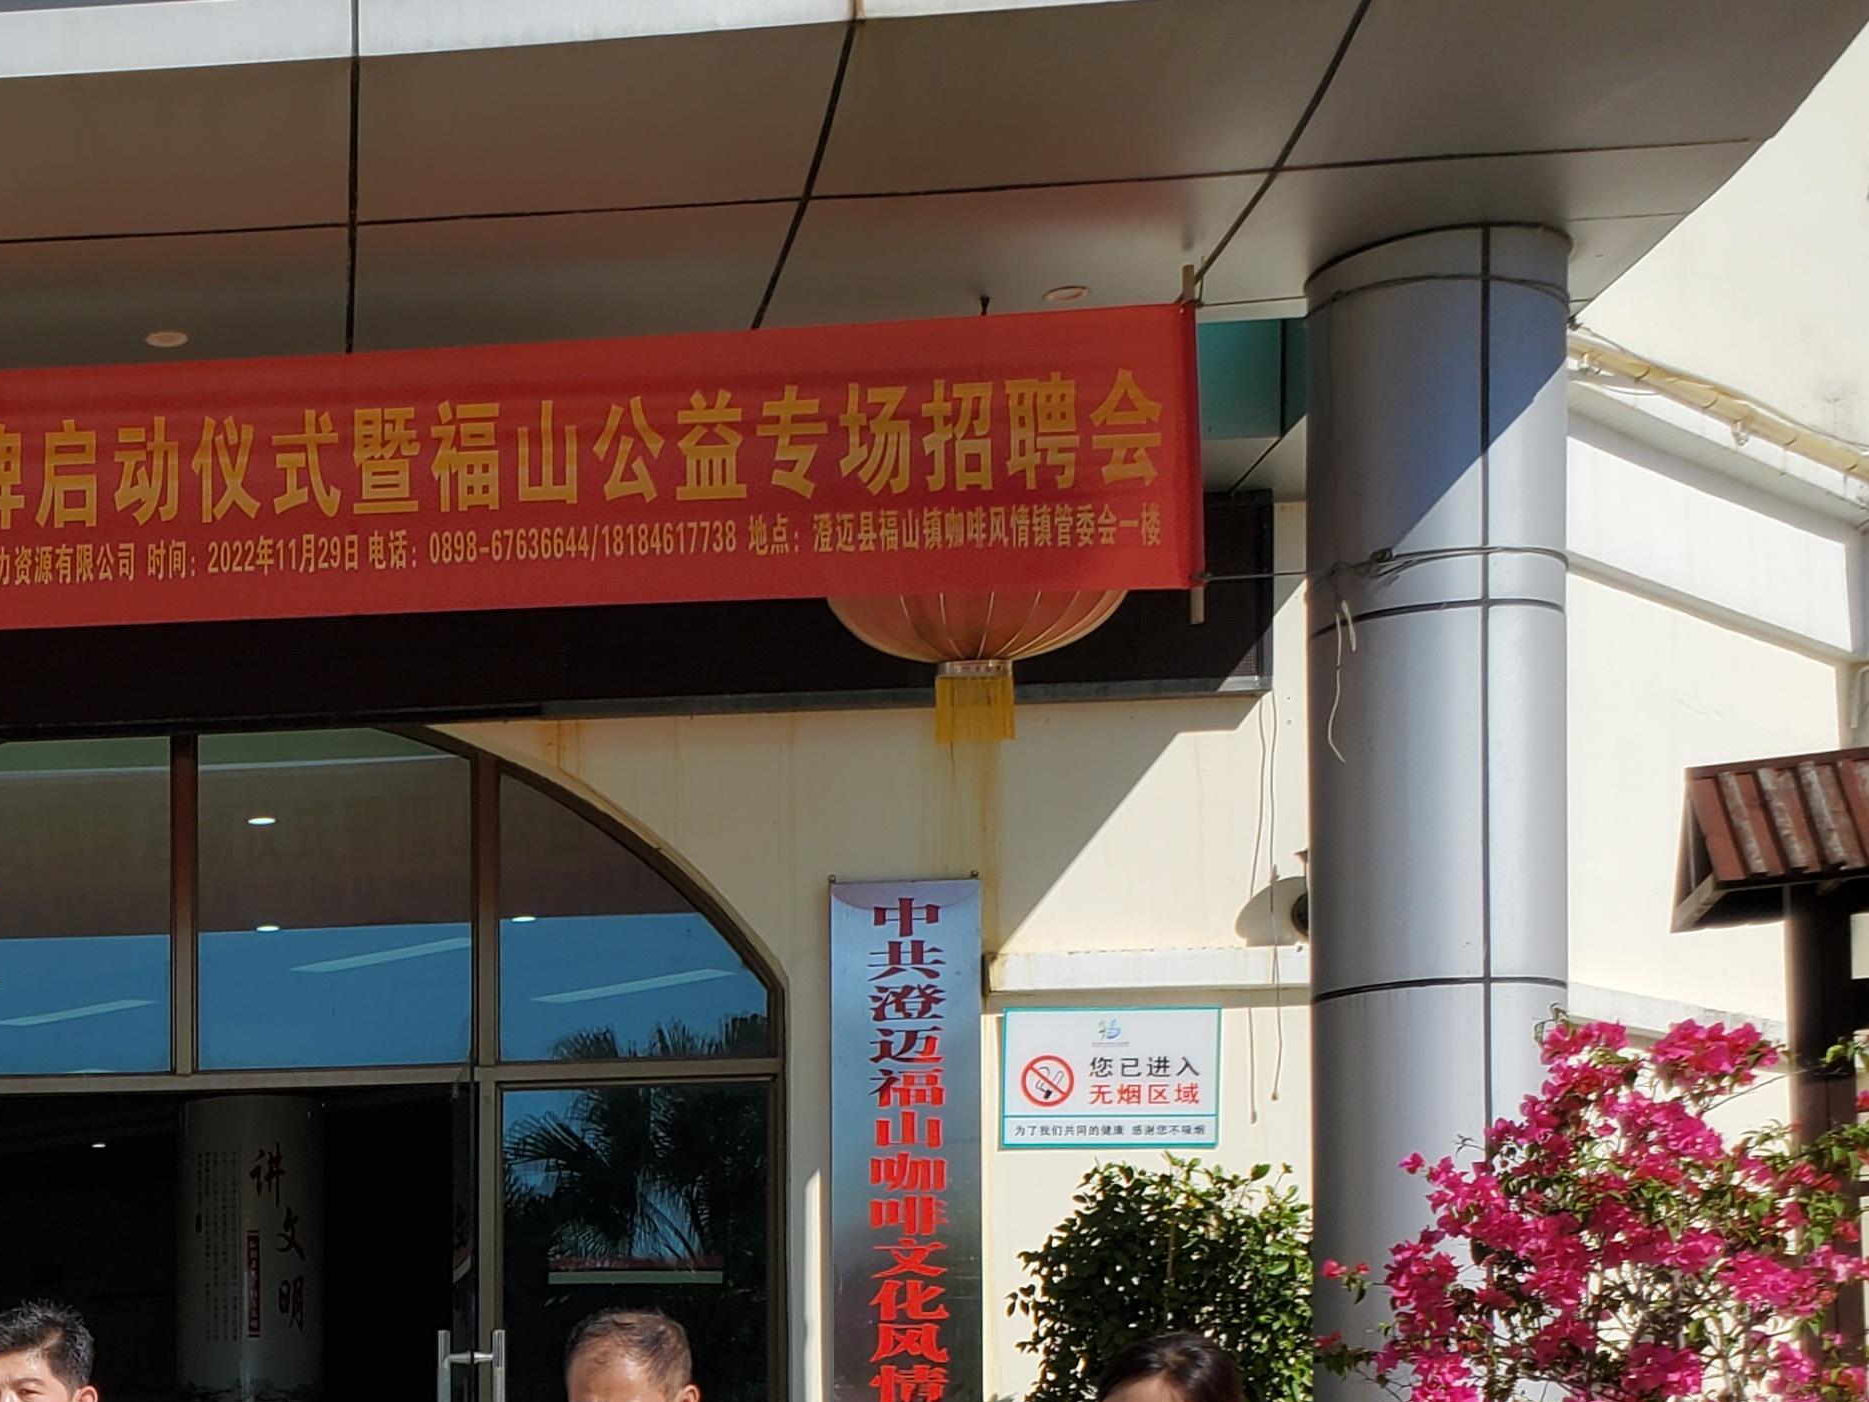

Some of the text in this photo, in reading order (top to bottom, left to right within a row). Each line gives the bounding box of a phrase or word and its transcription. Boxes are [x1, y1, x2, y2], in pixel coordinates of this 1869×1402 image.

[1089, 1056, 1200, 1078] 您已进入
[1089, 1083, 1200, 1105] 无烟区域
[1014, 1125, 1124, 1137] 为了我们共同的健康
[249, 1141, 306, 1332] 讲文明
